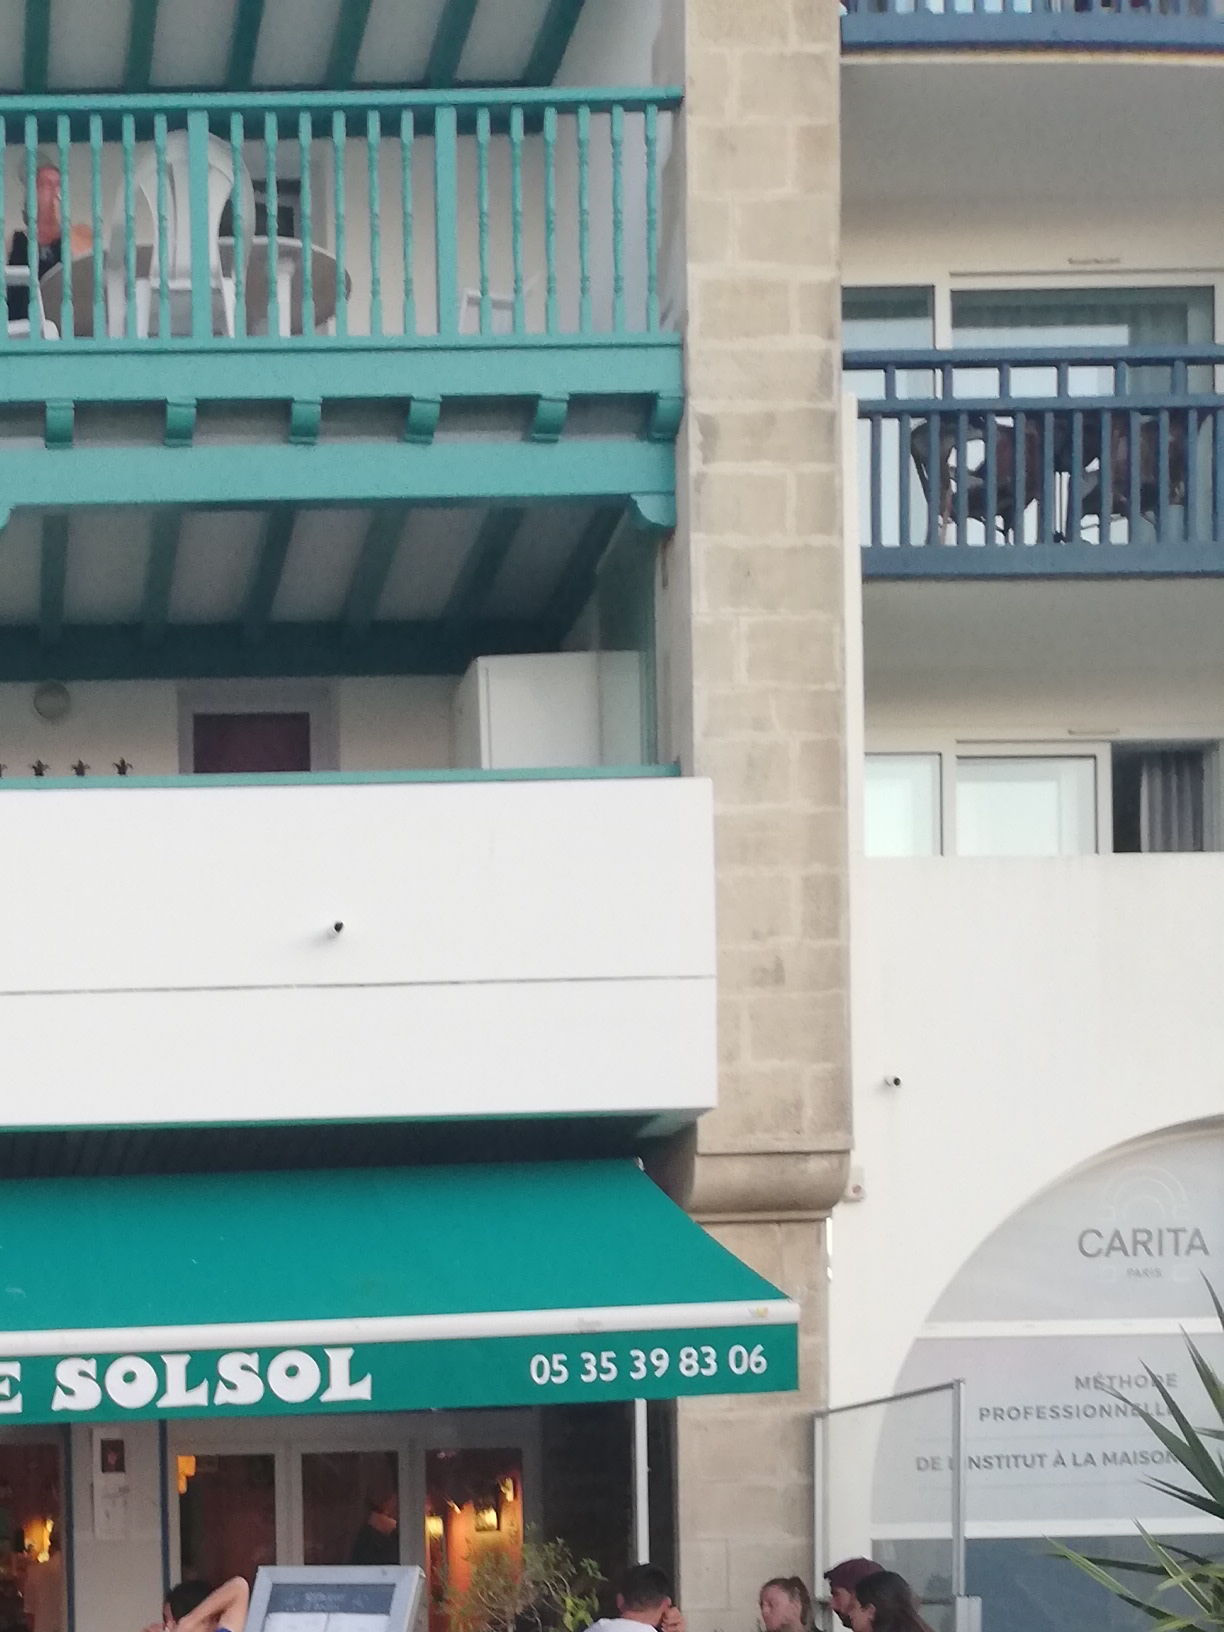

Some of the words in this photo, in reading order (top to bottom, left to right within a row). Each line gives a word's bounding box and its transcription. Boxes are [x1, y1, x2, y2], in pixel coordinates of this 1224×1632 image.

[1078, 1227, 1210, 1258] CARITA
[1126, 1267, 1163, 1279] PARIS
[51, 1347, 373, 1412] SOLSOL
[529, 1353, 569, 1385] 05
[580, 1351, 619, 1383] 35
[629, 1347, 670, 1380] 39
[679, 1345, 718, 1378] 83
[728, 1344, 768, 1375] 06
[978, 1400, 1174, 1422] PROFESSIONNELL
[916, 1455, 944, 1471] DE
[947, 1453, 1048, 1471] LNSTITUT
[1053, 1448, 1068, 1468] À
[1072, 1451, 1097, 1468] LA
[1102, 1450, 1178, 1467] MAISON
